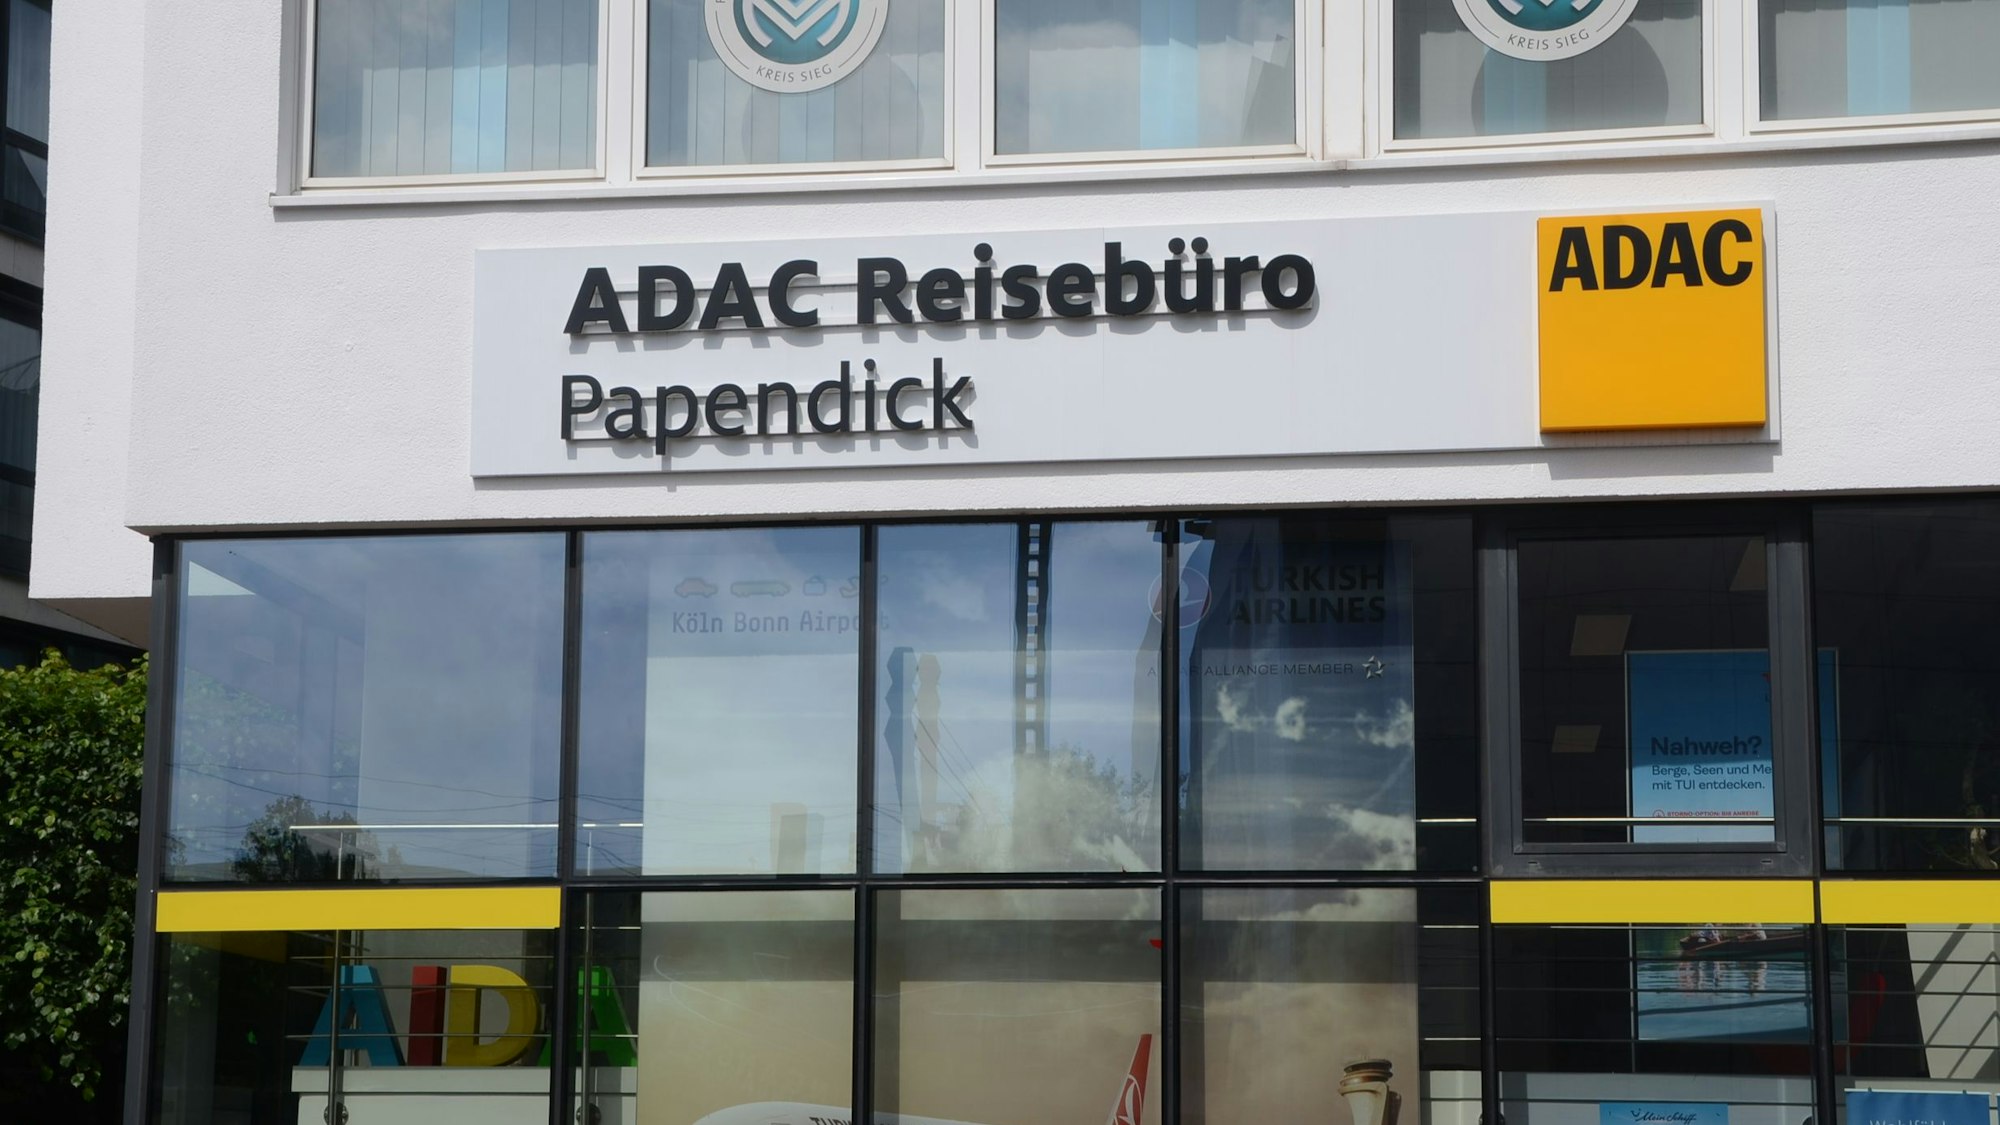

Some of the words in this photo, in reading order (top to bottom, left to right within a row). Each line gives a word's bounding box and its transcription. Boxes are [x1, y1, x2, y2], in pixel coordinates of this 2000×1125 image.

[1507, 33, 1549, 50] KREIS
[1555, 29, 1590, 49] SIEG
[756, 65, 795, 83] KREIS
[801, 64, 832, 83] SIEG
[1548, 218, 1753, 292] ADAC
[563, 259, 818, 334] ADAC
[857, 237, 1316, 324] Reisebüro
[561, 357, 974, 456] Papendick
[1230, 565, 1385, 592] TURKISH
[1226, 596, 1386, 625] AIRLINES
[672, 611, 723, 633] Köln
[734, 611, 789, 632] Bonn
[1204, 664, 1279, 677] ALLIANCE
[1283, 663, 1354, 676] MEMBER
[1650, 735, 1762, 757] Nahweh?
[1652, 764, 1690, 778] Berge,
[1693, 764, 1724, 776] Seen
[1726, 763, 1749, 775] und
[1752, 763, 1772, 775] Me
[1652, 779, 1672, 790] mit
[1674, 780, 1696, 790] TUI
[1698, 779, 1765, 790] entdecken.
[298, 964, 638, 1067] AIDA
